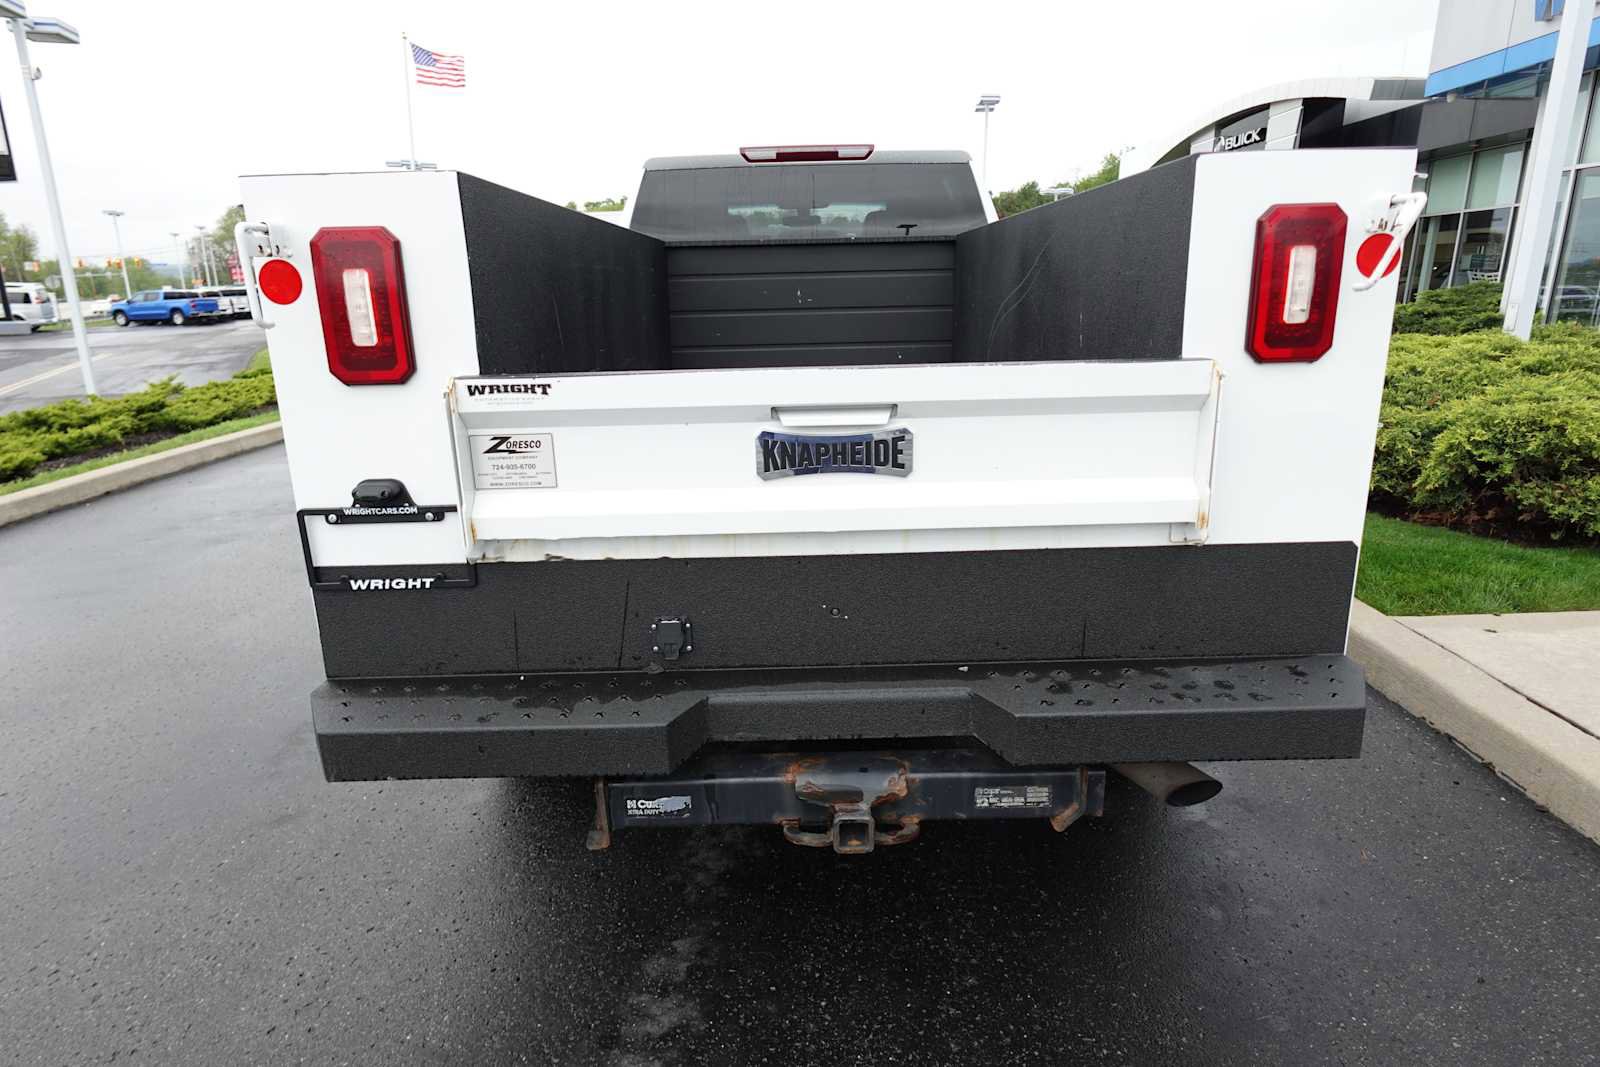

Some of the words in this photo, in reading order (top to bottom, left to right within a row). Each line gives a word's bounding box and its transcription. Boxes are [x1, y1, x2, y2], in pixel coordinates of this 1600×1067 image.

[1224, 128, 1261, 150] BUICK
[467, 384, 552, 396] WRIGHT
[482, 436, 543, 454] ZORESCO
[763, 436, 905, 472] KNAPHEIDE
[343, 506, 418, 515] WRIGHTCARS.COM
[349, 578, 435, 590] WRIGHT
